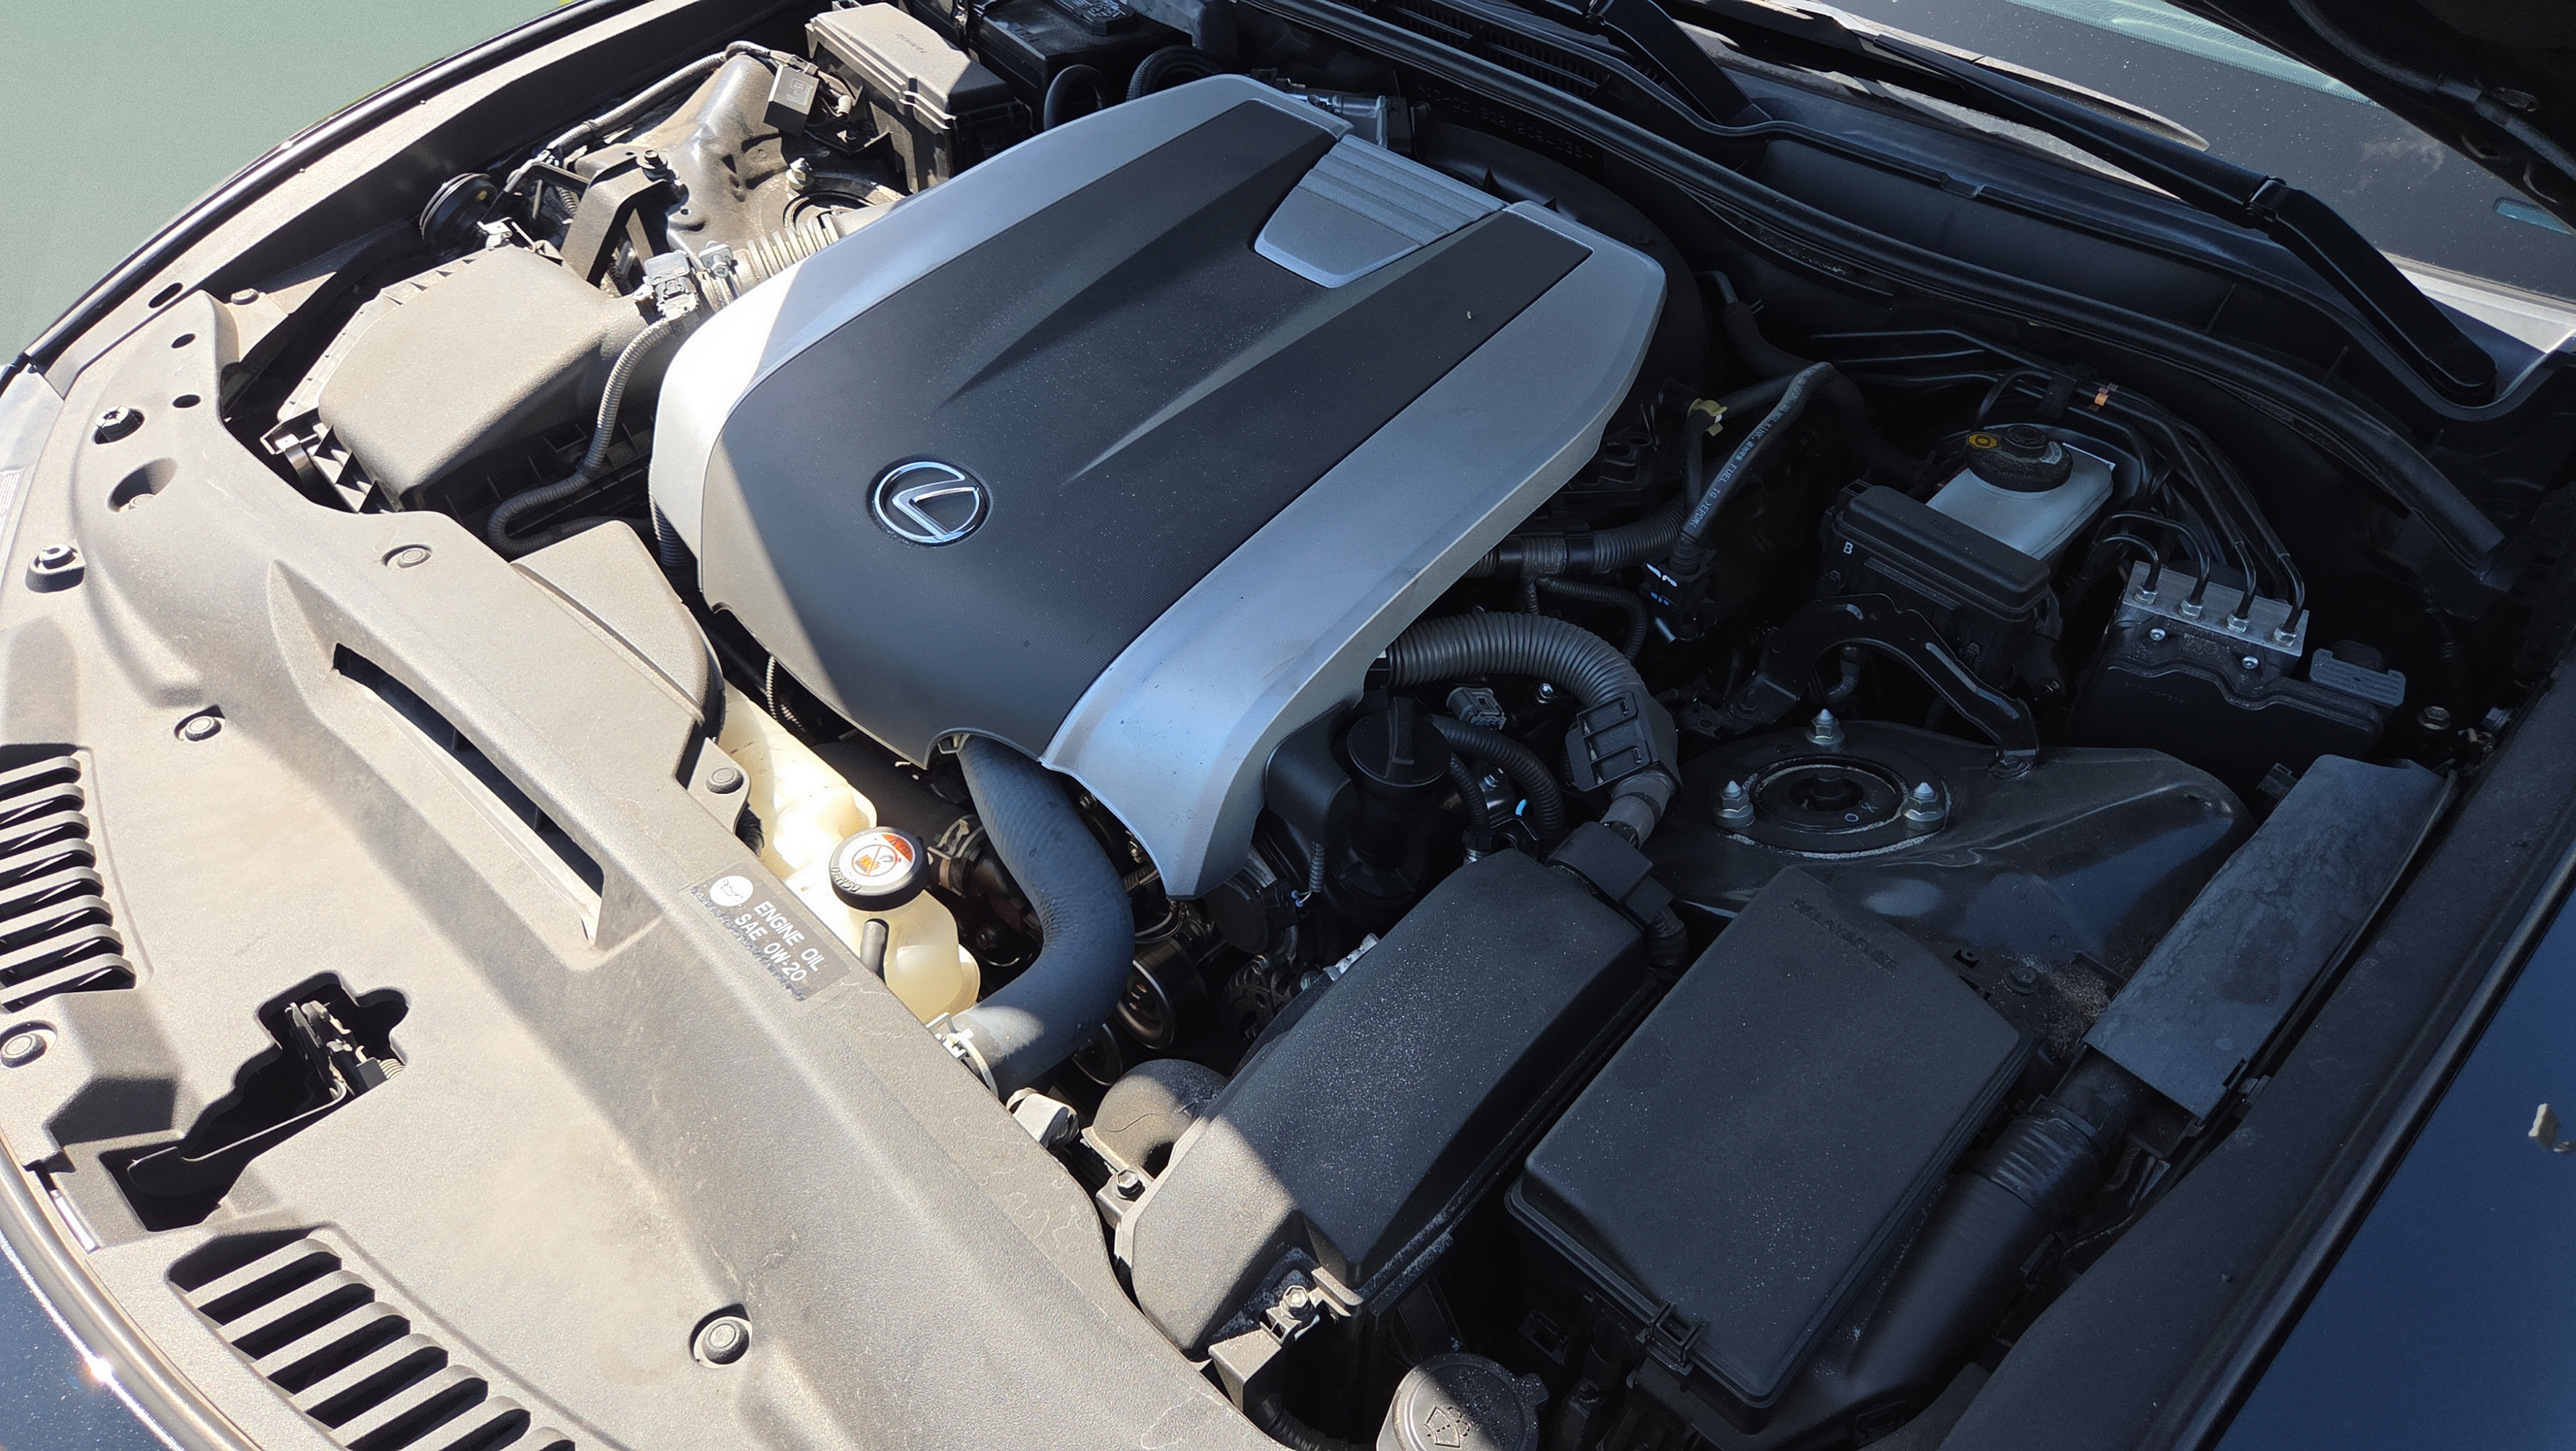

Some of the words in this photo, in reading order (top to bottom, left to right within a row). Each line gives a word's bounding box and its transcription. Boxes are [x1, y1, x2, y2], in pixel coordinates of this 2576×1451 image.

[1718, 462, 1737, 485] FUEL
[1709, 487, 1721, 498] TG
[1843, 541, 1854, 555] B
[735, 914, 768, 941] SAE
[753, 901, 805, 947] ENGINE
[801, 948, 825, 972] OIL
